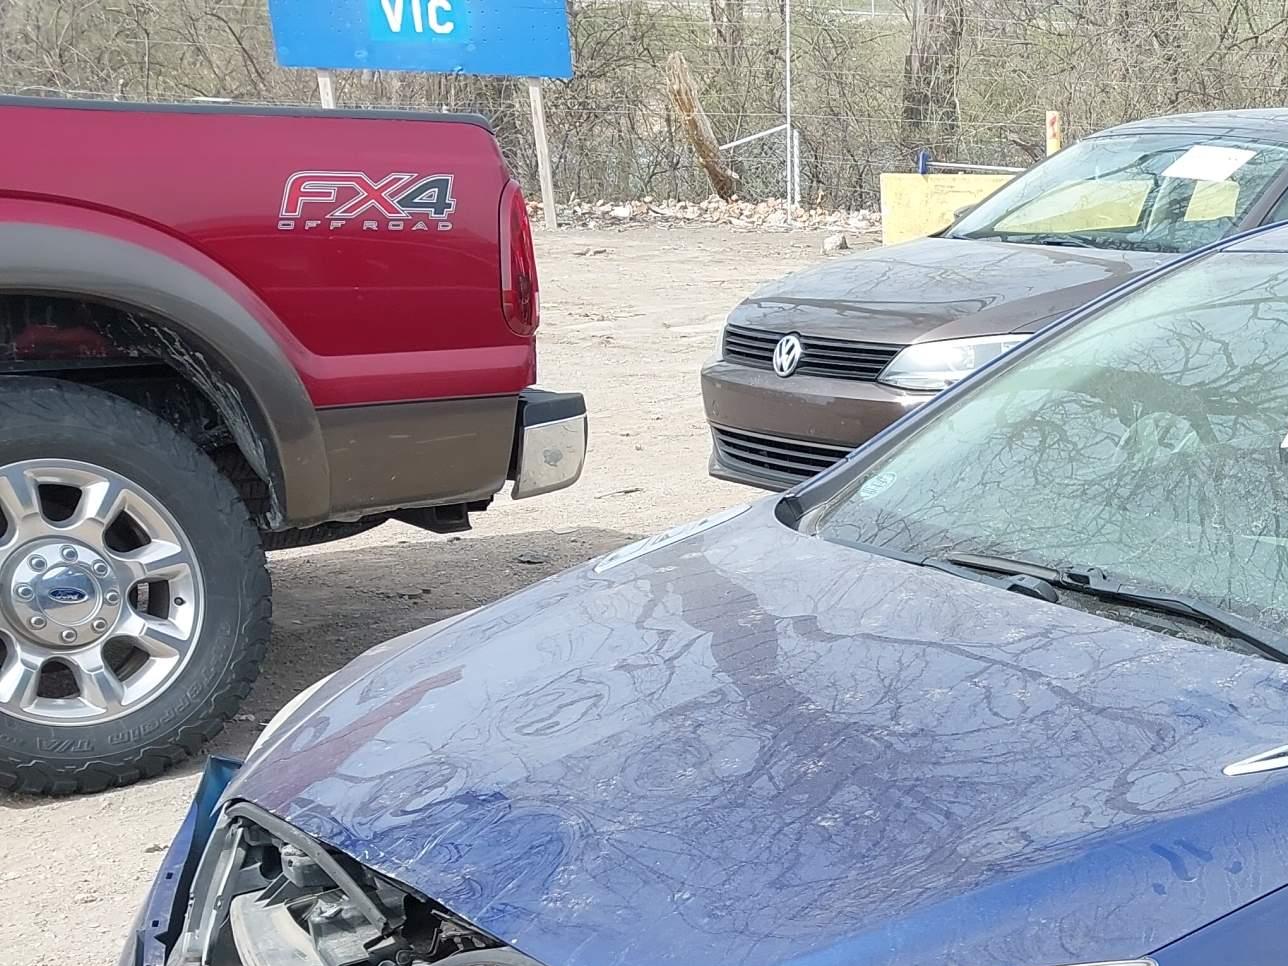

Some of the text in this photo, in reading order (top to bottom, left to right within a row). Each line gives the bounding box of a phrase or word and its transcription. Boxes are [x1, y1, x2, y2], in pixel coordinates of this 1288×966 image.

[380, 0, 454, 34] VIC
[279, 170, 456, 219] FX4
[278, 220, 452, 231] OFF ROAD
